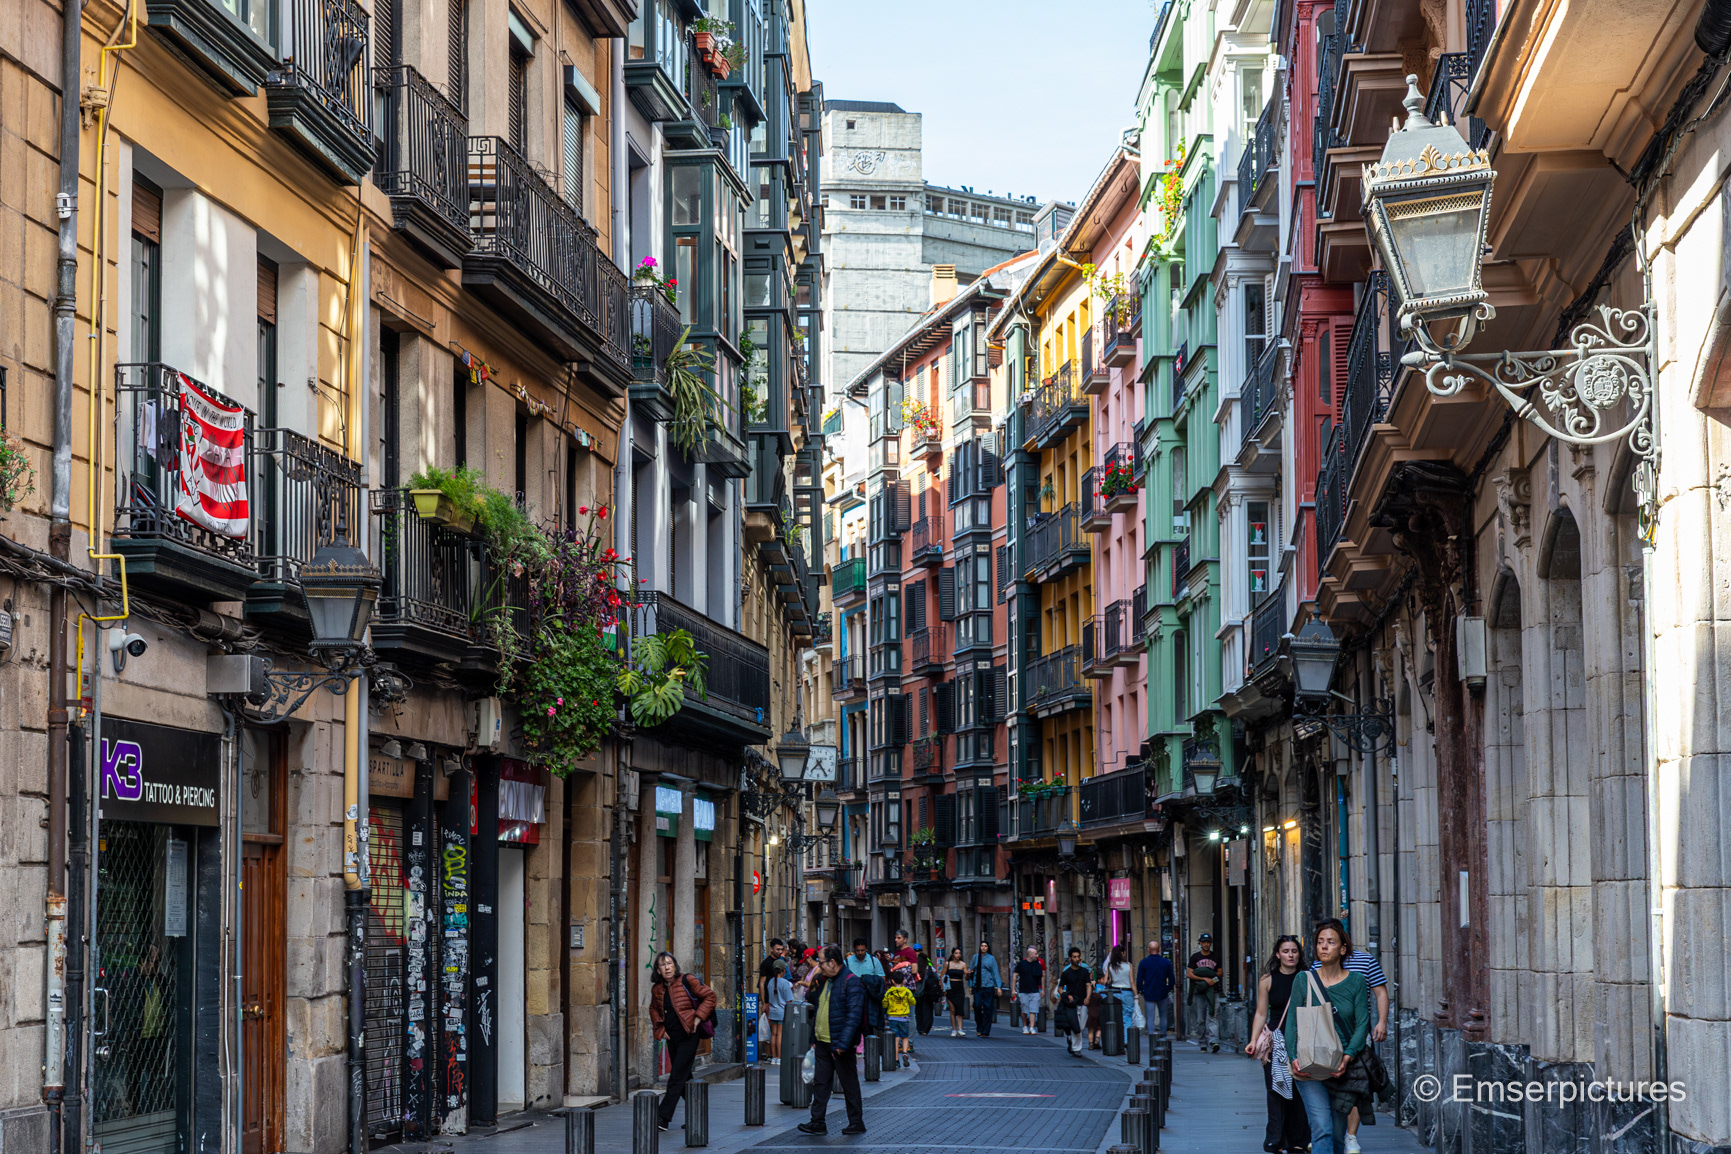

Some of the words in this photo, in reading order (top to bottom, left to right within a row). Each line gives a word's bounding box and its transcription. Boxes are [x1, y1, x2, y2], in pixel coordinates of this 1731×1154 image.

[101, 737, 143, 802] K3
[144, 781, 174, 804] TATTOO
[175, 784, 182, 805] &
[182, 785, 215, 808] PIERCING
